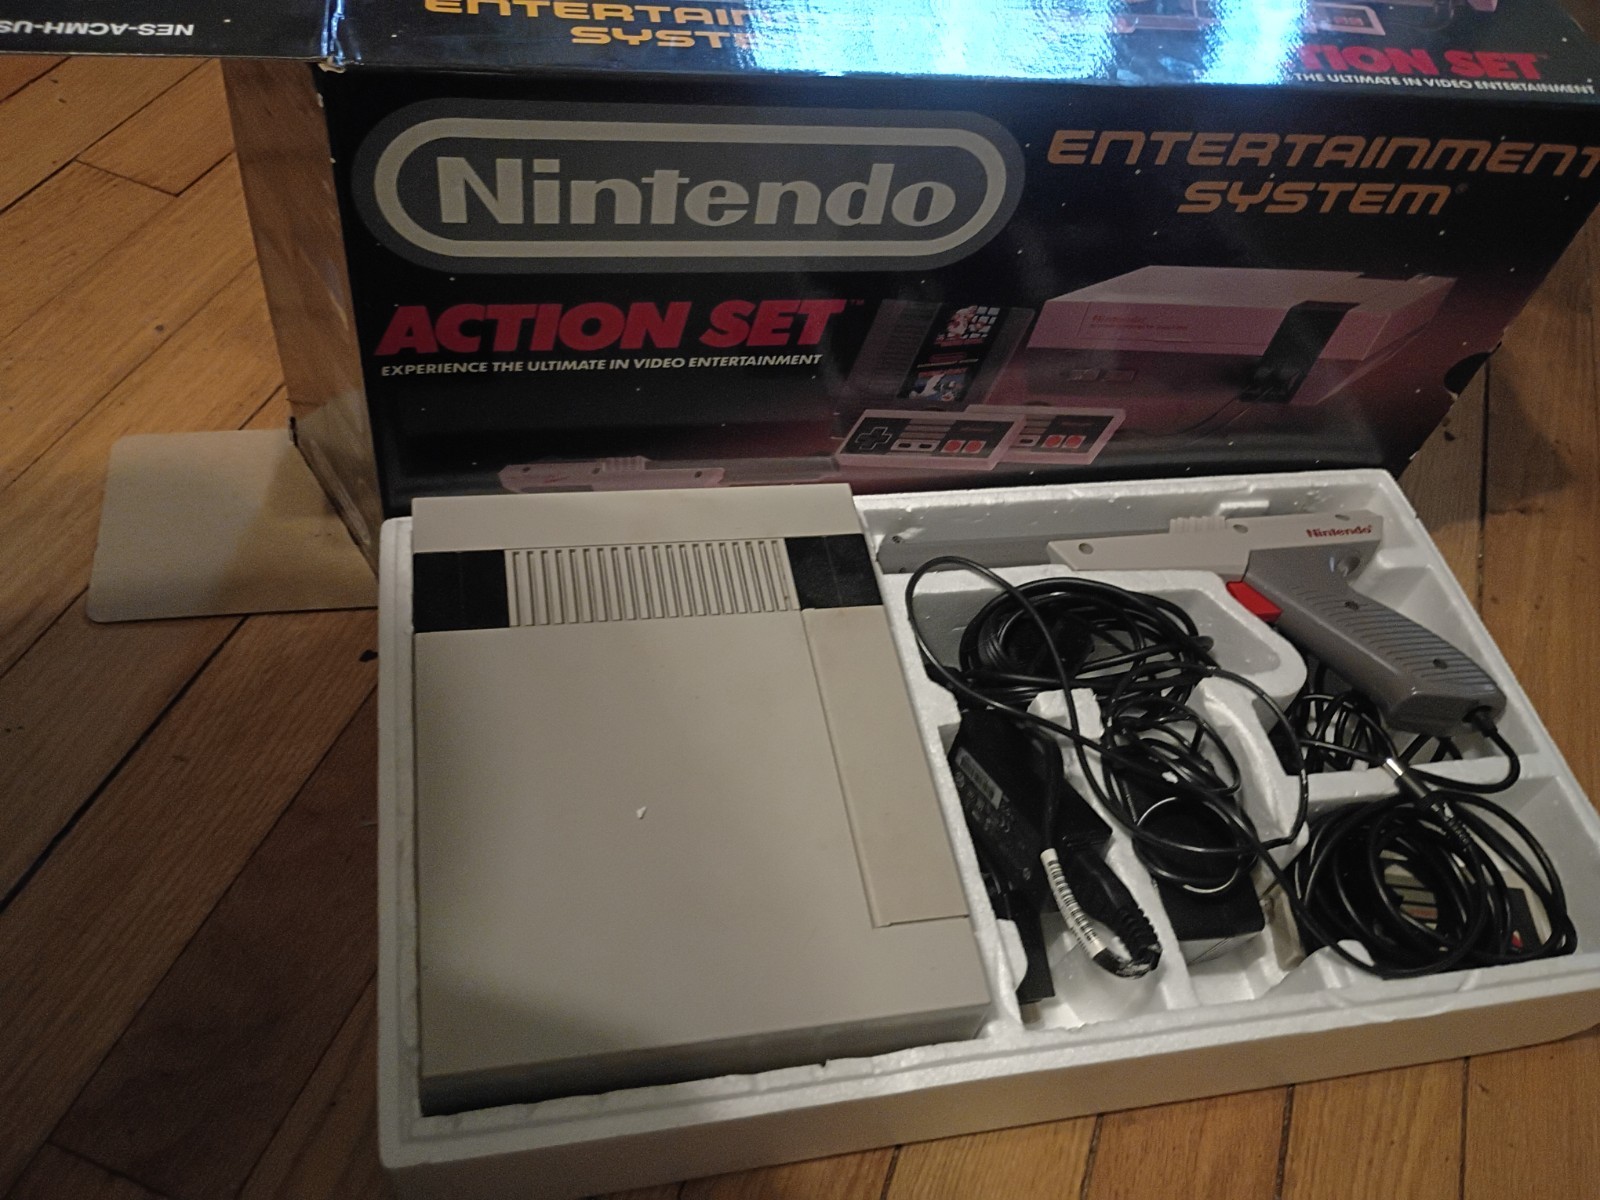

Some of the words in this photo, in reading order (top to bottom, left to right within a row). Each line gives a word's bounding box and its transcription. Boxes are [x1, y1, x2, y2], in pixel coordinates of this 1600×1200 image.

[1443, 49, 1541, 80] SET
[1293, 73, 1325, 83] THE
[1327, 73, 1402, 86] ULTIMATE
[1403, 77, 1424, 87] IN
[1424, 77, 1474, 90] VIDEO
[1474, 80, 1596, 95] ENTERTAINMENT
[1047, 130, 1600, 178] ENTERTAINMENT
[436, 156, 957, 227] Nintendo
[1177, 181, 1452, 216] SYSTEM
[373, 301, 692, 356] ACTION
[699, 298, 848, 348] SET
[380, 361, 488, 378] EXPERIENCE
[493, 361, 524, 373] THE
[527, 359, 607, 372] ULTIMATE
[609, 359, 630, 371] IN
[633, 356, 686, 370] VIDEO
[688, 353, 824, 369] ENTERTAINMENT
[1306, 525, 1371, 538] Nintendo
